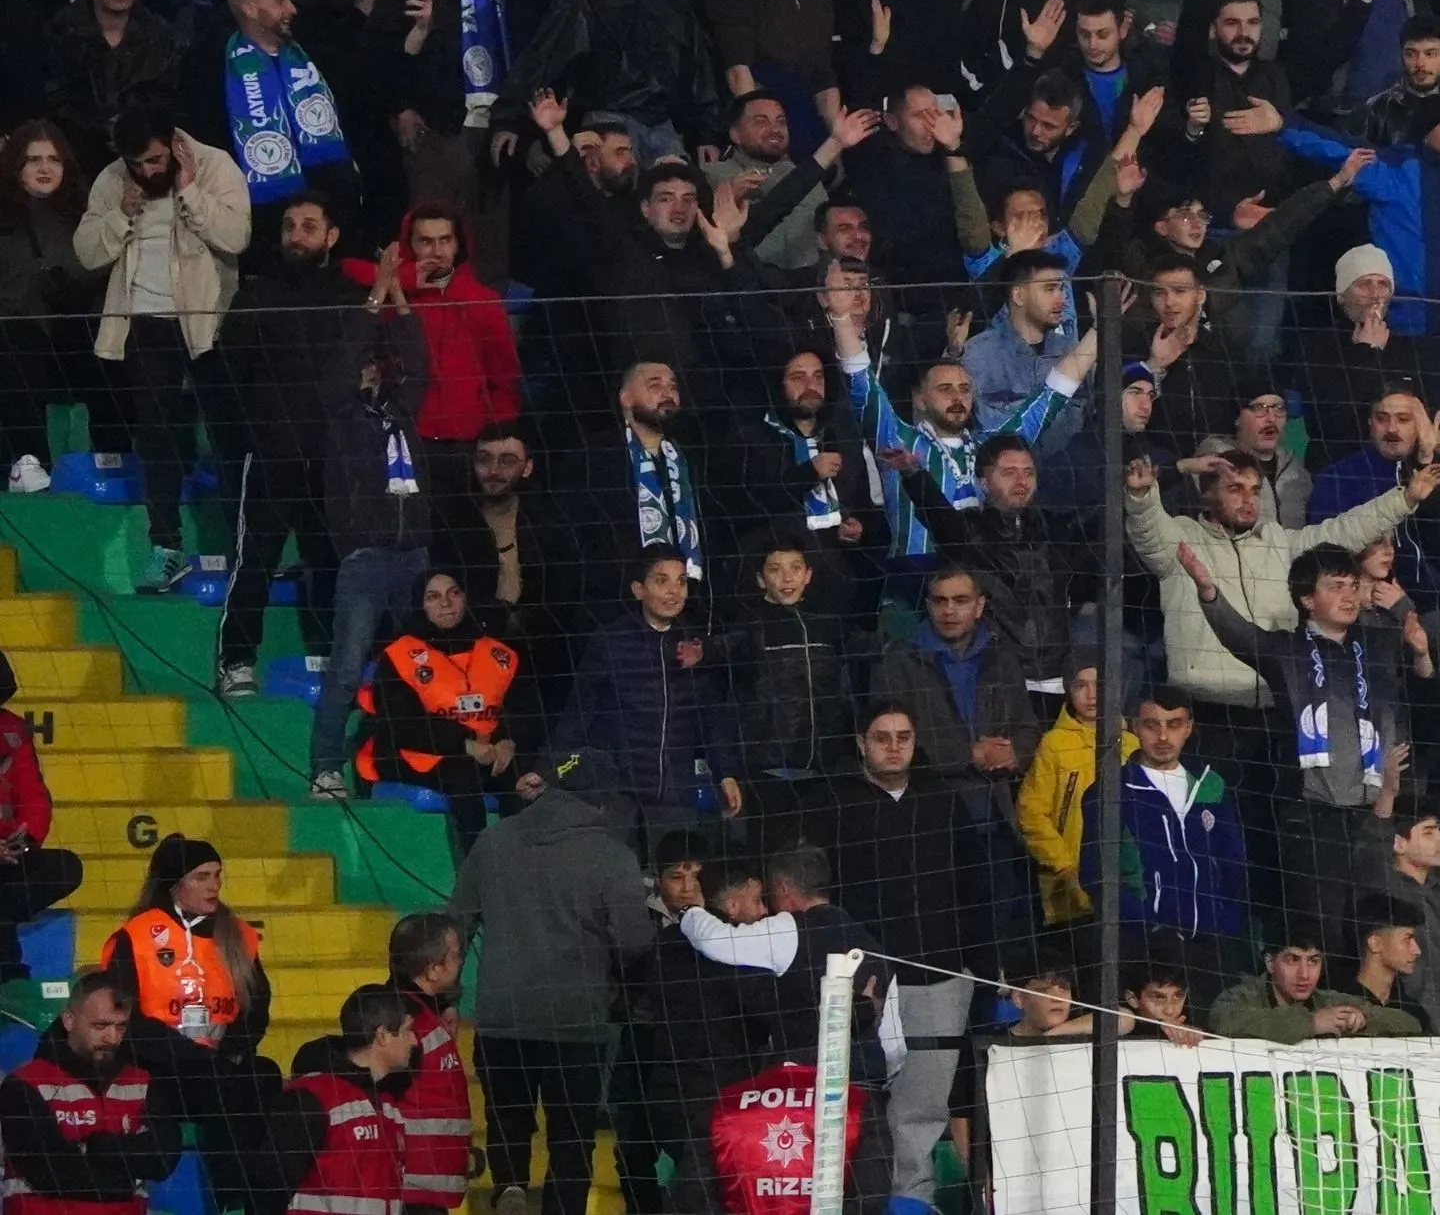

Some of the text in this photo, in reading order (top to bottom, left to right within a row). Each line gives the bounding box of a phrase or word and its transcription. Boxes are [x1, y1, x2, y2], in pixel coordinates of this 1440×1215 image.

[24, 711, 54, 744] H
[127, 815, 158, 849] G
[739, 1087, 817, 1110] POLİ
